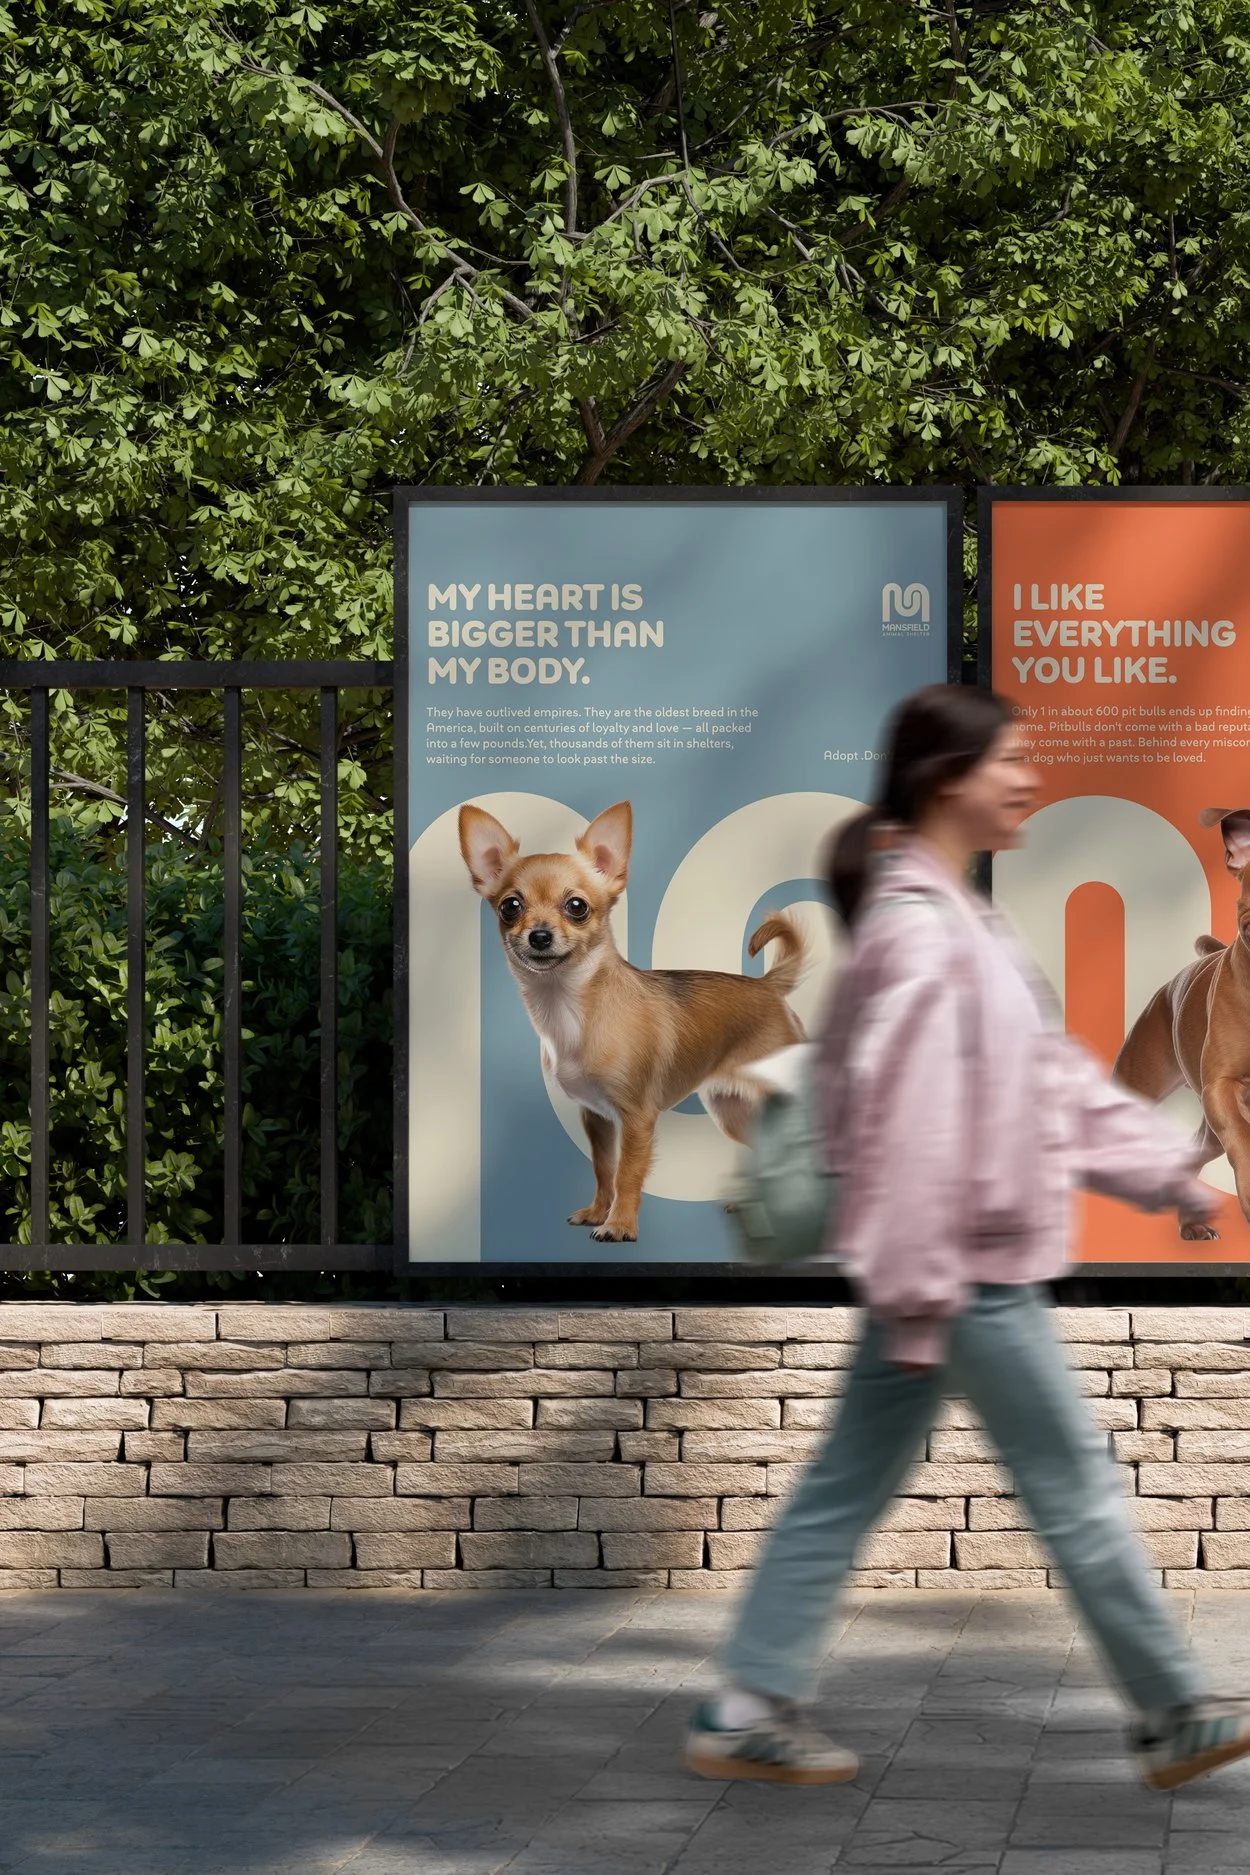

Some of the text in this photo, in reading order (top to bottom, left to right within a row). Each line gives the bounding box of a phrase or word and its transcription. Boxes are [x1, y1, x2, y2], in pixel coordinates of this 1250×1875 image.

[428, 584, 643, 610] MY HEART IS
[1014, 584, 1104, 610] I LIKE
[428, 621, 664, 647] BIGGER THAN
[882, 623, 930, 632] MANSFIELD
[1014, 620, 1236, 647] EVERYTHING
[428, 657, 590, 684] MY BODY.
[1012, 657, 1177, 684] YOU LIKE.
[425, 706, 759, 720] They have outlived empires. They are the oldest breed in the
[1011, 705, 1039, 719] Only
[1047, 705, 1059, 717] in
[1060, 705, 1094, 717] about
[1095, 705, 1120, 717] 600
[1121, 705, 1137, 719] pit
[1139, 705, 1167, 717] bulls
[1168, 705, 1196, 717] ends
[1198, 708, 1213, 719] up
[426, 721, 752, 736] America, built on centuries of loyalty and love all packed
[1049, 720, 1092, 732] Pitbulls
[1093, 720, 1123, 732] don't
[1124, 723, 1156, 732] come
[1158, 720, 1183, 732] with
[1185, 724, 1192, 732] a
[1194, 720, 1216, 732] bad
[426, 737, 449, 749] into
[450, 740, 457, 749] a
[459, 737, 481, 749] few
[548, 737, 609, 749] thousands
[610, 737, 623, 749] of
[624, 737, 655, 749] them
[656, 737, 672, 749] sit
[673, 737, 684, 749] in
[686, 737, 734, 750] shelters,
[1013, 736, 1037, 750] hey
[1038, 739, 1070, 748] come
[1071, 736, 1097, 748] with
[1098, 739, 1106, 748] a
[1108, 737, 1136, 750] past.
[1138, 736, 1177, 748] Behind
[1179, 737, 1211, 750] every
[425, 752, 657, 767] waiting for someone to look past the size.
[1032, 751, 1055, 766] dog
[1056, 751, 1081, 763] who
[1082, 752, 1104, 766] just
[1105, 753, 1141, 763] wants
[1142, 753, 1154, 763] to
[1156, 751, 1171, 763] be
[1172, 751, 1206, 763] loved.
